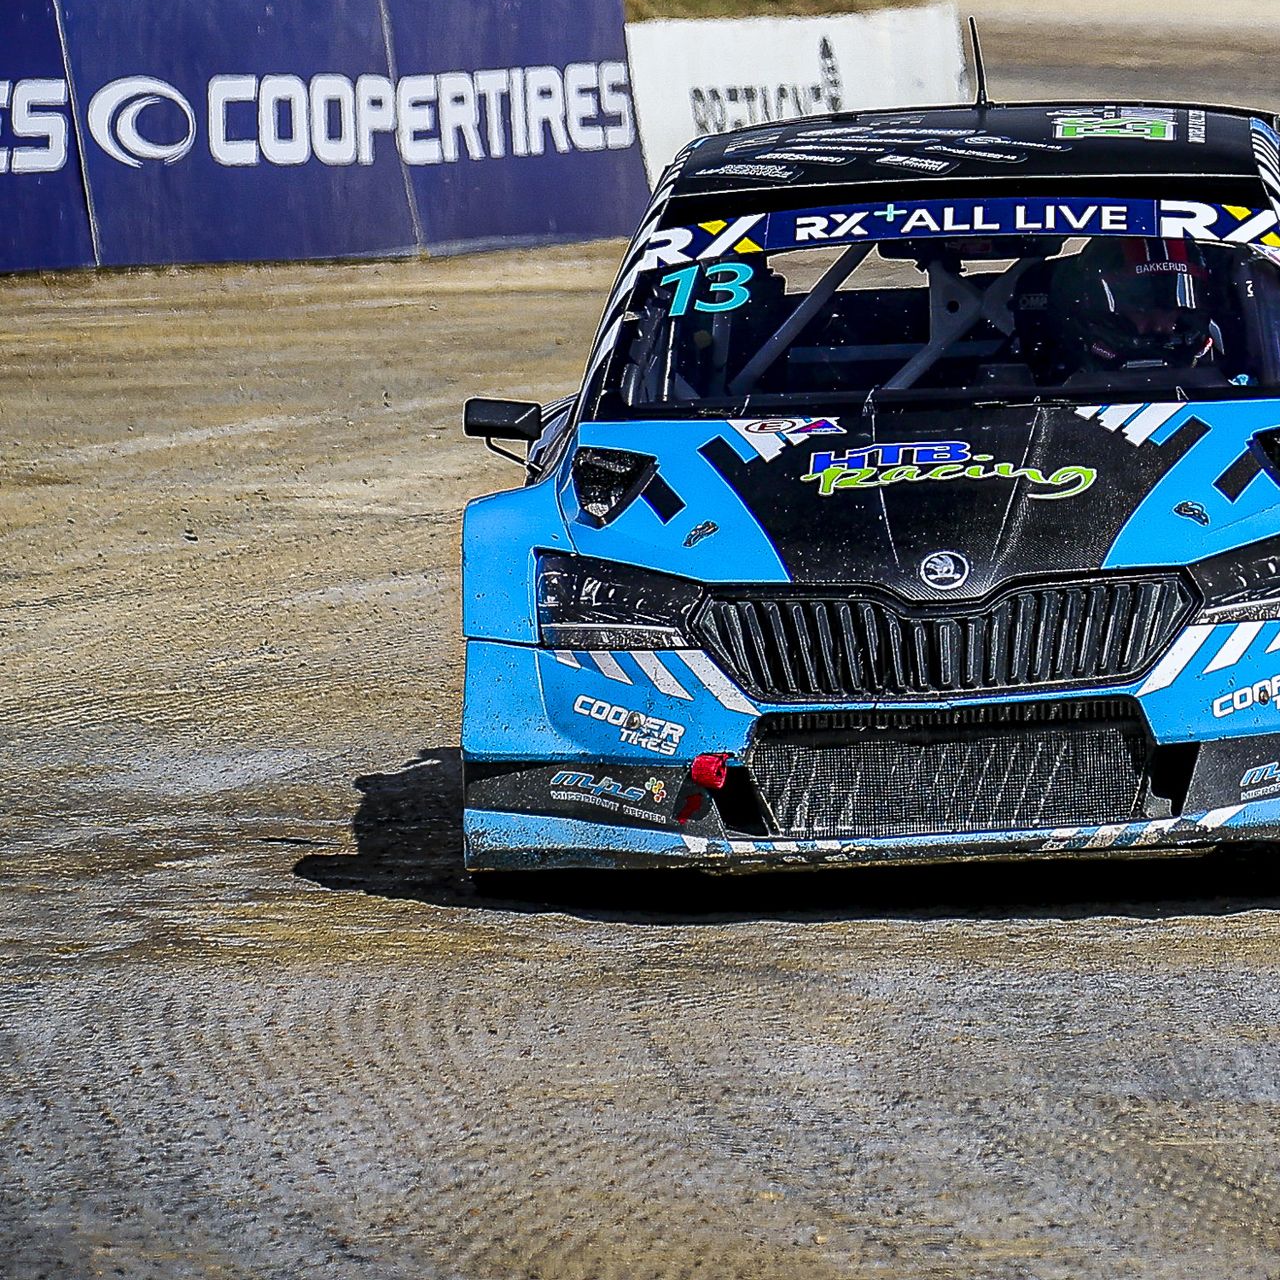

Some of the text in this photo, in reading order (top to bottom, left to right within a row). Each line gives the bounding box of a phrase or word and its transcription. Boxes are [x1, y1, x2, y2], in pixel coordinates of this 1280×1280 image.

[901, 206, 1000, 233] ALL
[1016, 205, 1127, 230] LIVE
[1136, 262, 1187, 274] BAKKERUD
[660, 262, 754, 317] 13
[811, 441, 970, 475] HTB
[801, 454, 1097, 499] Racing
